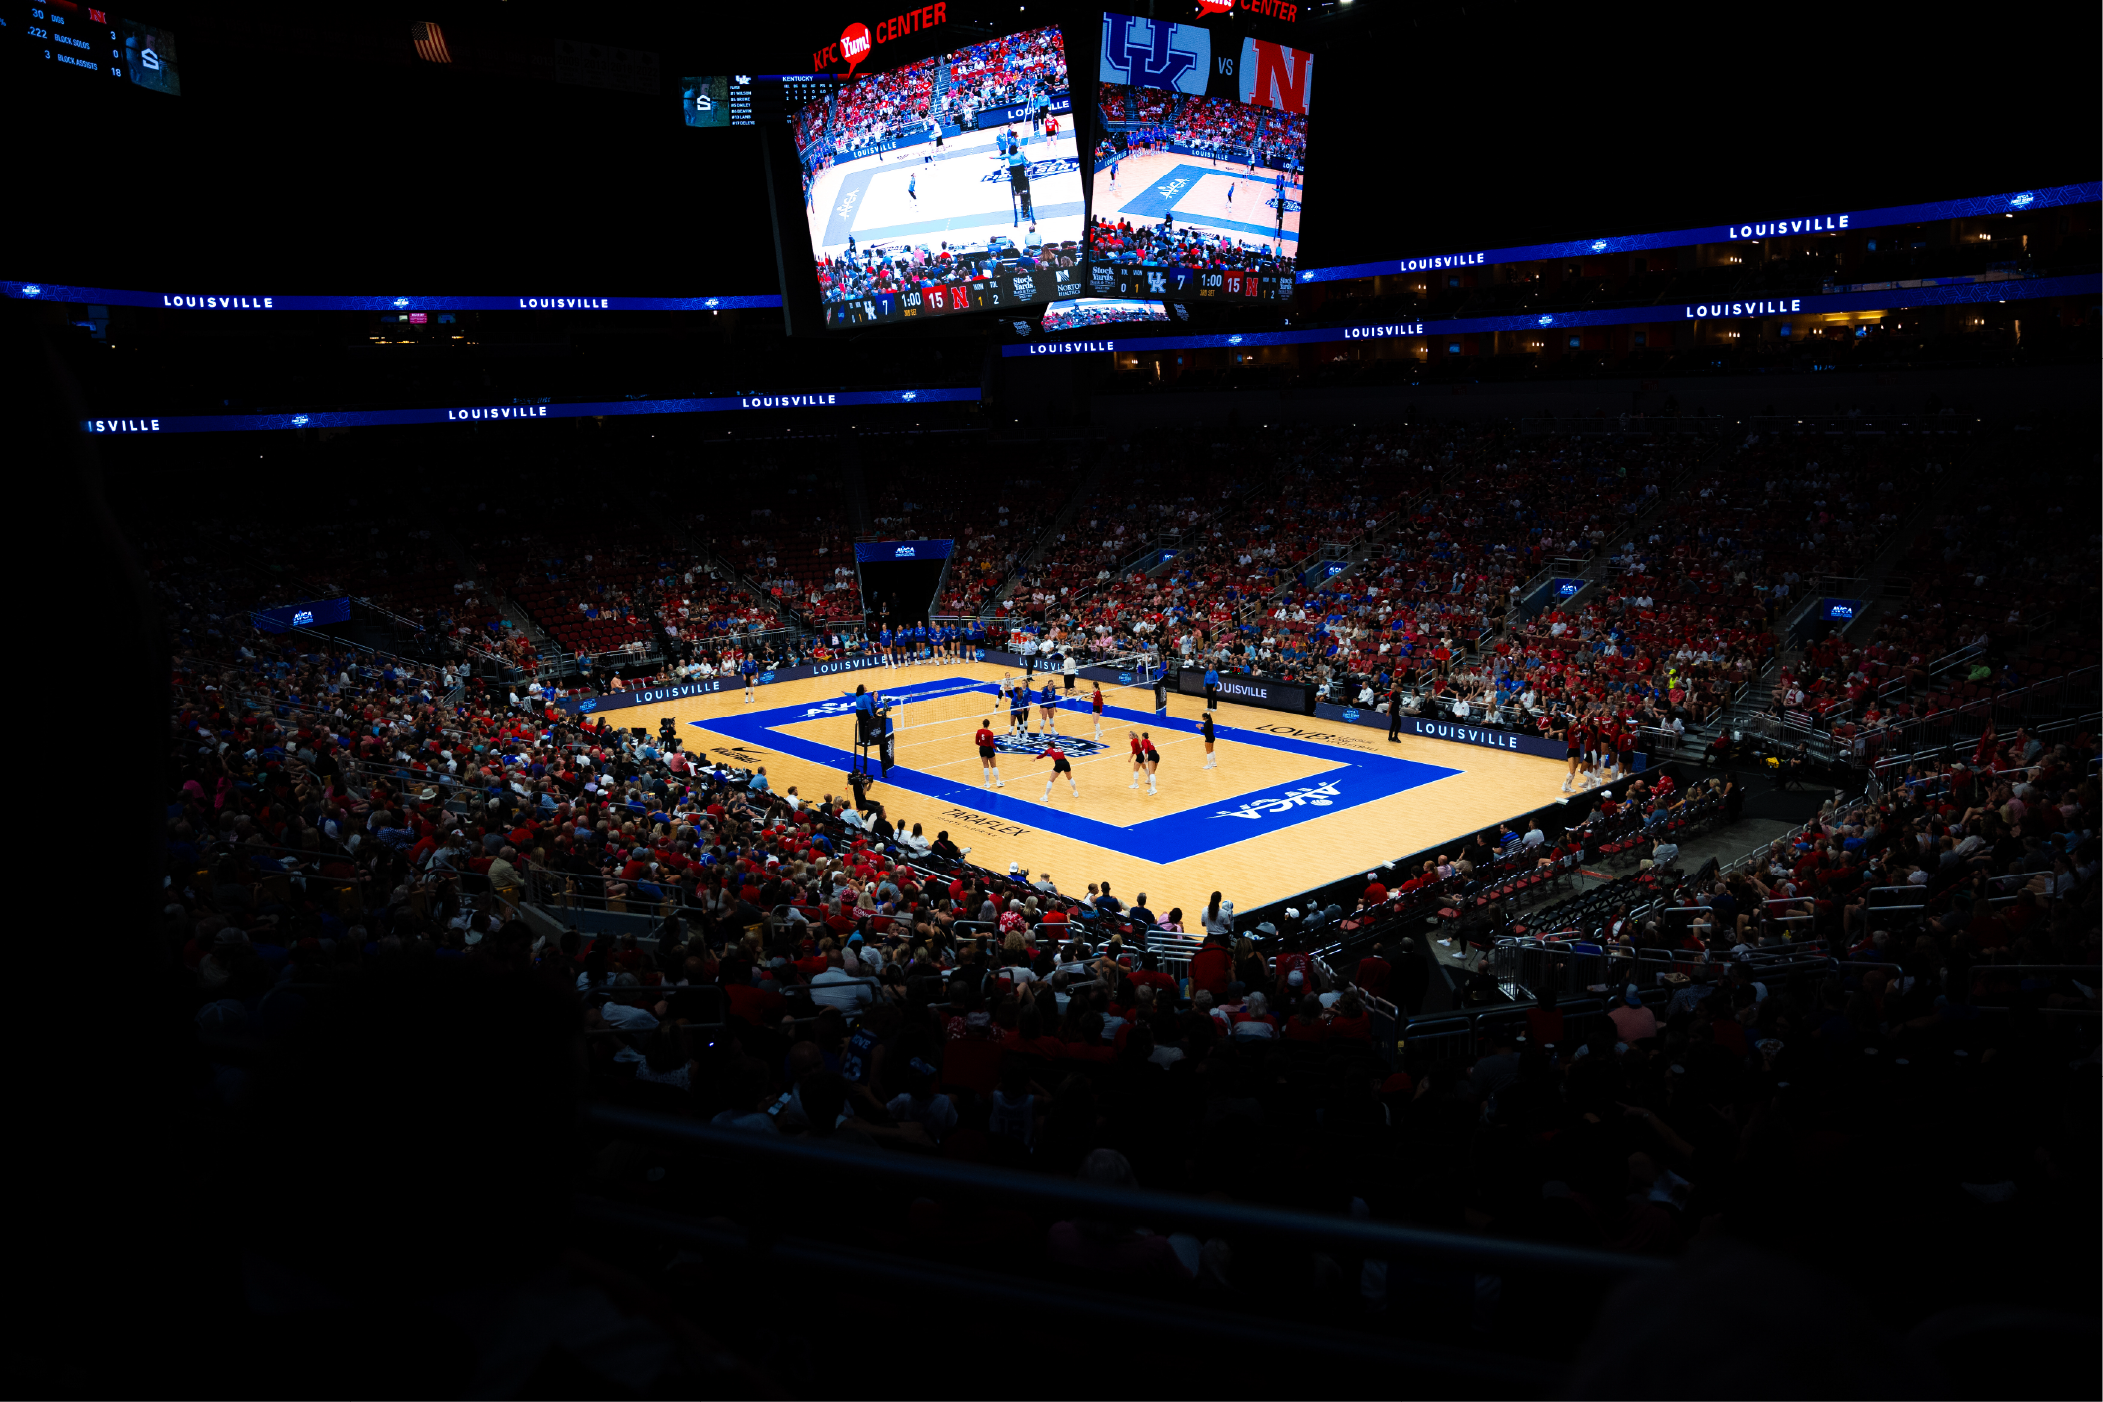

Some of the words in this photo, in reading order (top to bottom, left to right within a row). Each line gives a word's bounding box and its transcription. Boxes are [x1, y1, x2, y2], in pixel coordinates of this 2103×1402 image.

[31, 8, 44, 20] 30
[110, 31, 117, 40] 3
[27, 26, 48, 39] .222
[112, 49, 119, 59] 0
[813, 43, 838, 72] KFC
[841, 28, 870, 58] Yum!
[876, 1, 946, 44] CENTER
[44, 50, 51, 60] 3
[111, 67, 122, 78] 18
[1218, 57, 1233, 76] VS
[1249, 38, 1314, 116] N
[1730, 216, 1848, 243] LOUISVILLE
[1401, 253, 1483, 271] LOUISVILLE
[1013, 275, 1033, 284] Stock
[1120, 283, 1127, 293] 0
[1177, 274, 1186, 290] 7
[1201, 274, 1222, 287] 1:00
[1228, 278, 1240, 292] 15
[1245, 277, 1258, 296] N
[1134, 284, 1139, 294] 1
[164, 296, 272, 307] LOUISVILLE
[520, 299, 608, 308] LOUISVILLE
[902, 292, 921, 308] 1:00
[928, 292, 944, 308] 15
[951, 286, 970, 310] N
[978, 296, 982, 306] 1
[993, 294, 999, 305] 2
[882, 300, 888, 316] 7
[1687, 300, 1800, 318] LOUISVILLE
[1345, 324, 1422, 341] LOUISVILLE
[1031, 342, 1116, 355] LOUISVILLE
[743, 395, 835, 407] LOUISVILLE
[449, 407, 546, 419] LOUISVILLE
[814, 654, 886, 675] LOUISVILLE
[1019, 658, 1079, 675] LUISVIE
[636, 681, 720, 703] LOUISVILLE
[1216, 681, 1268, 698] OUISVILLE
[1416, 722, 1517, 749] LOUISVILLE
[942, 808, 1030, 836] TARAFLEX
